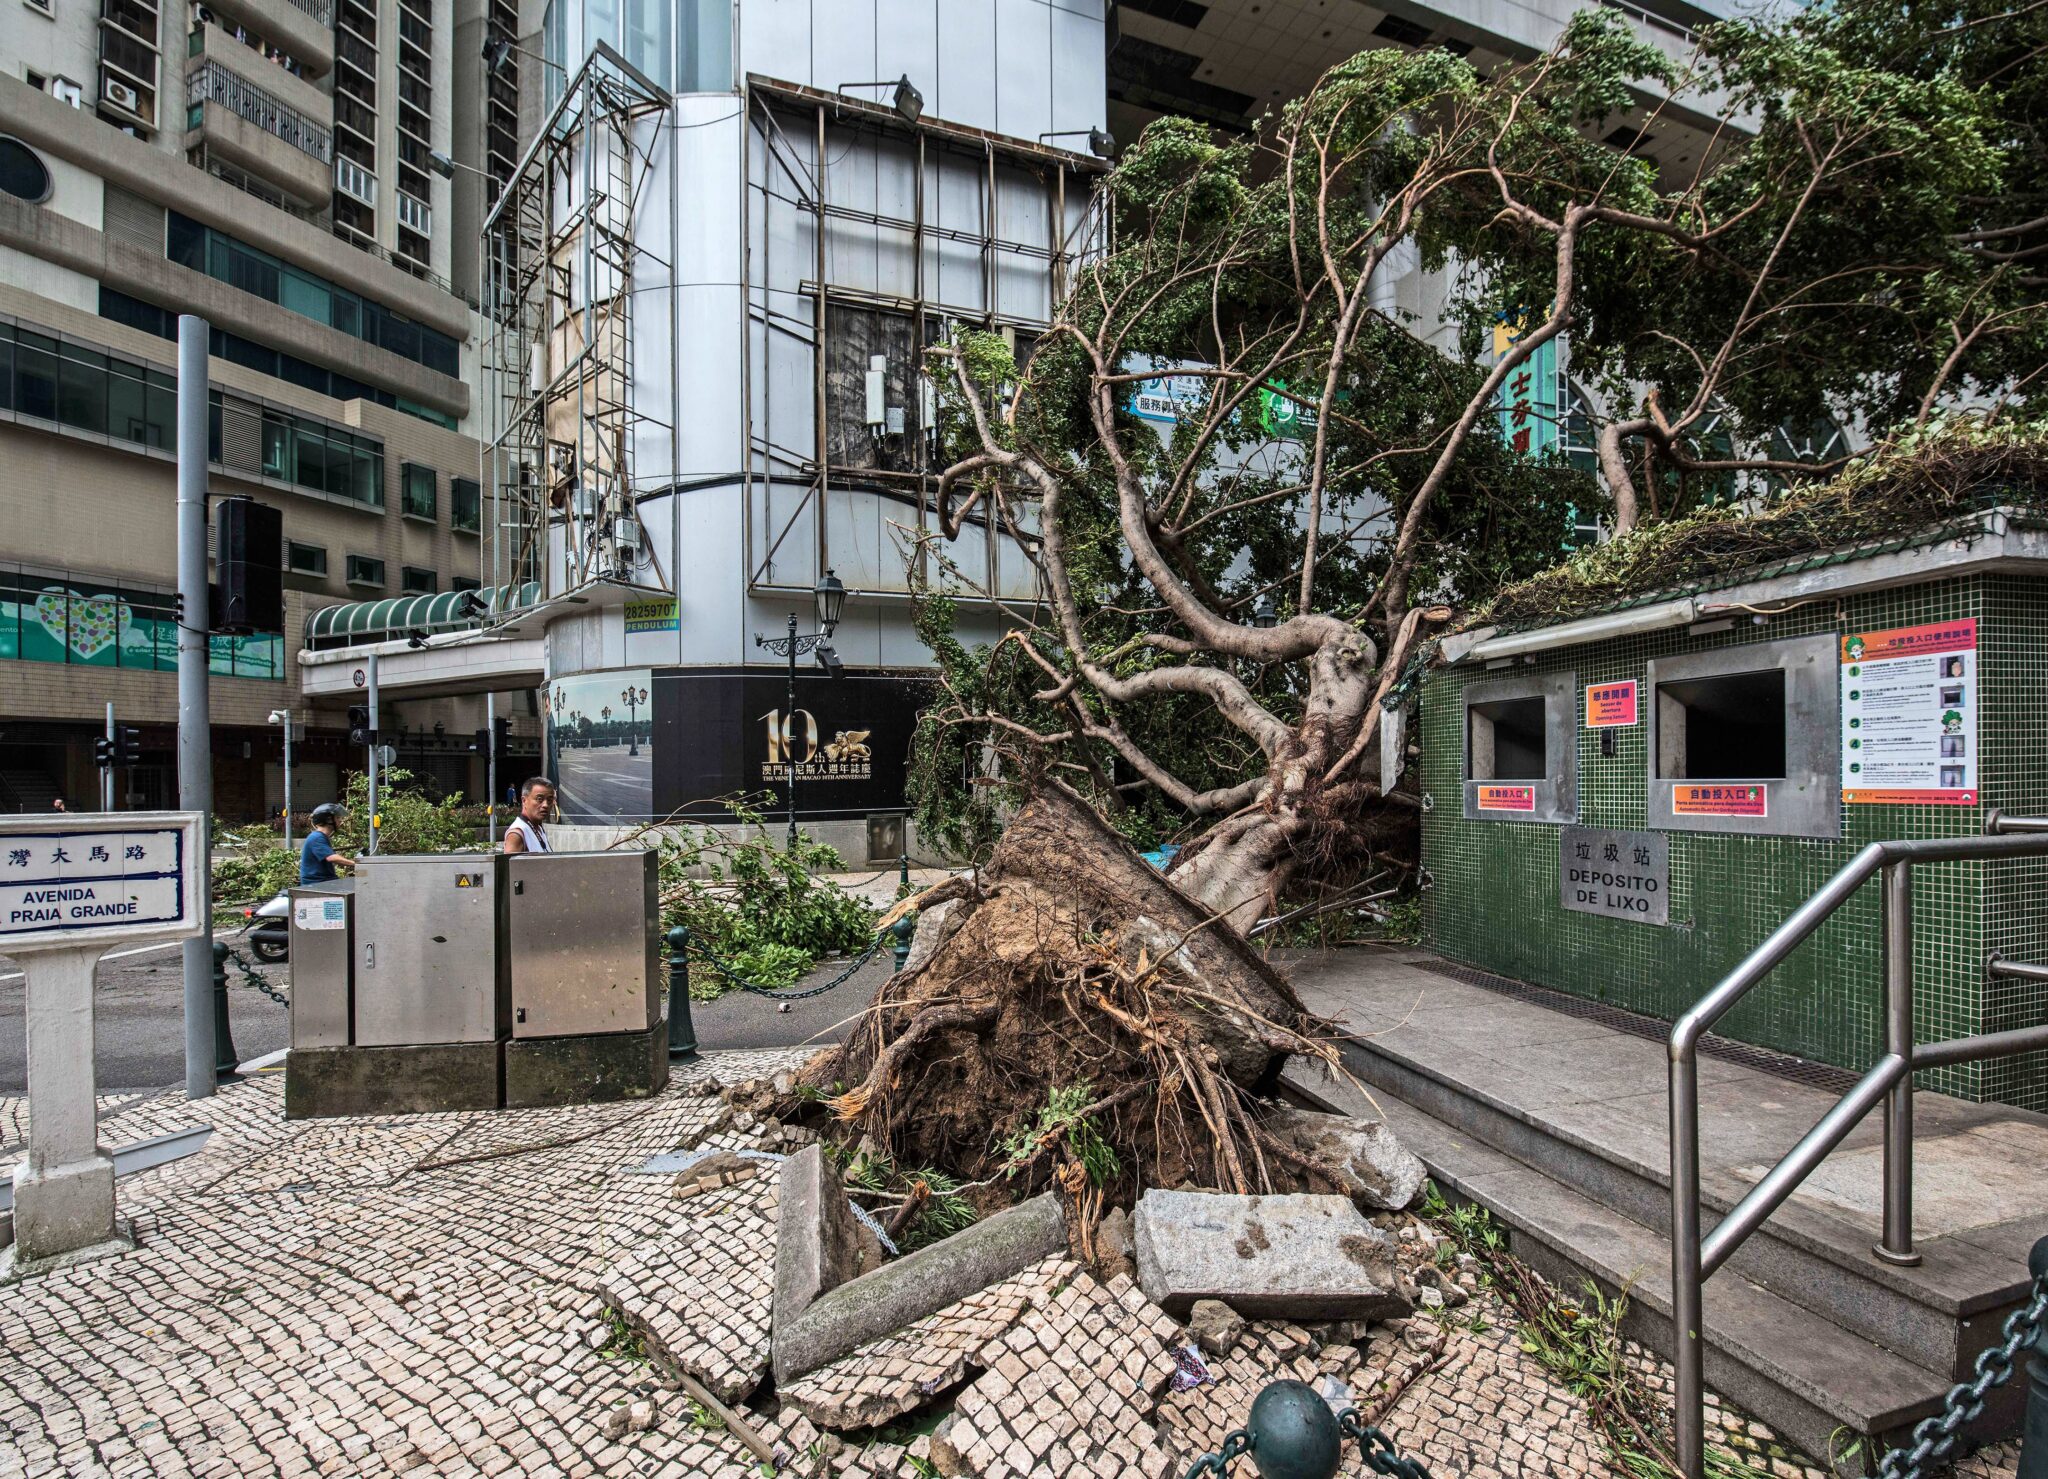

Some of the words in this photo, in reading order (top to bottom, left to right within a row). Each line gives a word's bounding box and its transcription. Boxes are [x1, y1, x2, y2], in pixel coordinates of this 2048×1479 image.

[626, 603, 677, 619] 28259707
[626, 620, 677, 631] PENDULUM
[1691, 789, 1746, 799] 自動投入口
[8, 844, 148, 867] 灣大馬路
[1576, 841, 1650, 867] 垃圾站
[1570, 868, 1658, 892] DEPOSITO
[23, 887, 96, 904] AVENIDA
[1577, 889, 1598, 905] DE
[1607, 893, 1650, 912] LIXO
[11, 907, 62, 923] PRAIA
[70, 902, 137, 918] GRANDE
